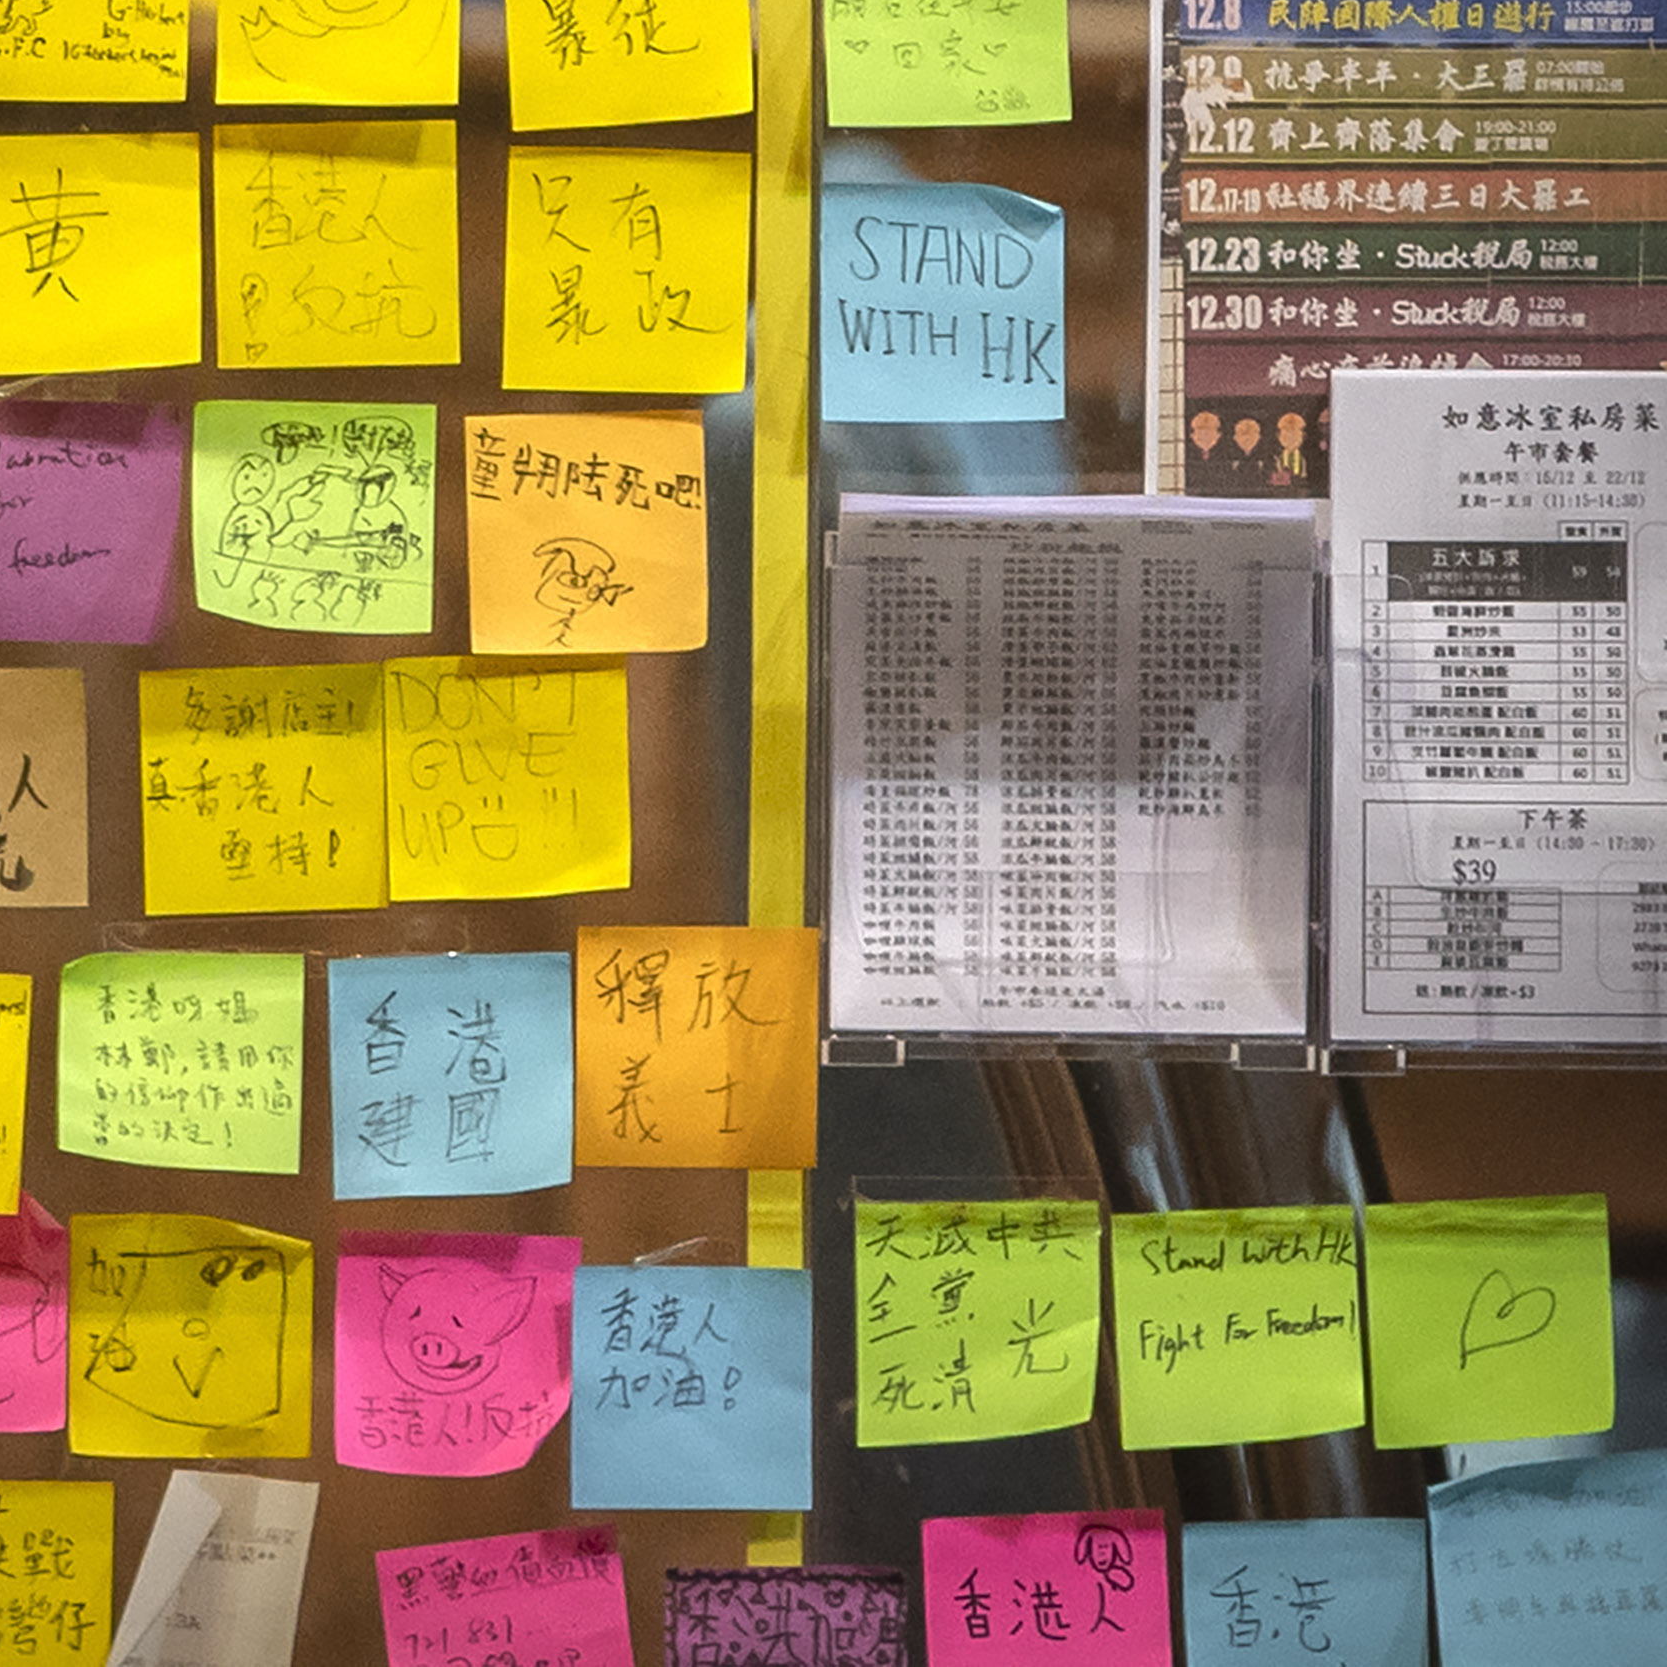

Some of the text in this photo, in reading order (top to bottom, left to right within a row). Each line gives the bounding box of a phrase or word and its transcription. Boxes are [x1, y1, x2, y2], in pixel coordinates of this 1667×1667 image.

[850, 218, 1033, 290] STAND
[1186, 238, 1261, 272] 12.23
[1186, 295, 1263, 330] 12.30
[838, 298, 1057, 385] WITH HK
[1444, 403, 1661, 432] 如意冰室私房菜
[1452, 859, 1497, 884] $39
[596, 947, 785, 1041] 釋放
[366, 992, 506, 1085] 香港
[1142, 1237, 1227, 1273] Stand
[1139, 1321, 1205, 1373] Fight
[953, 1567, 1127, 1640] 香港人
